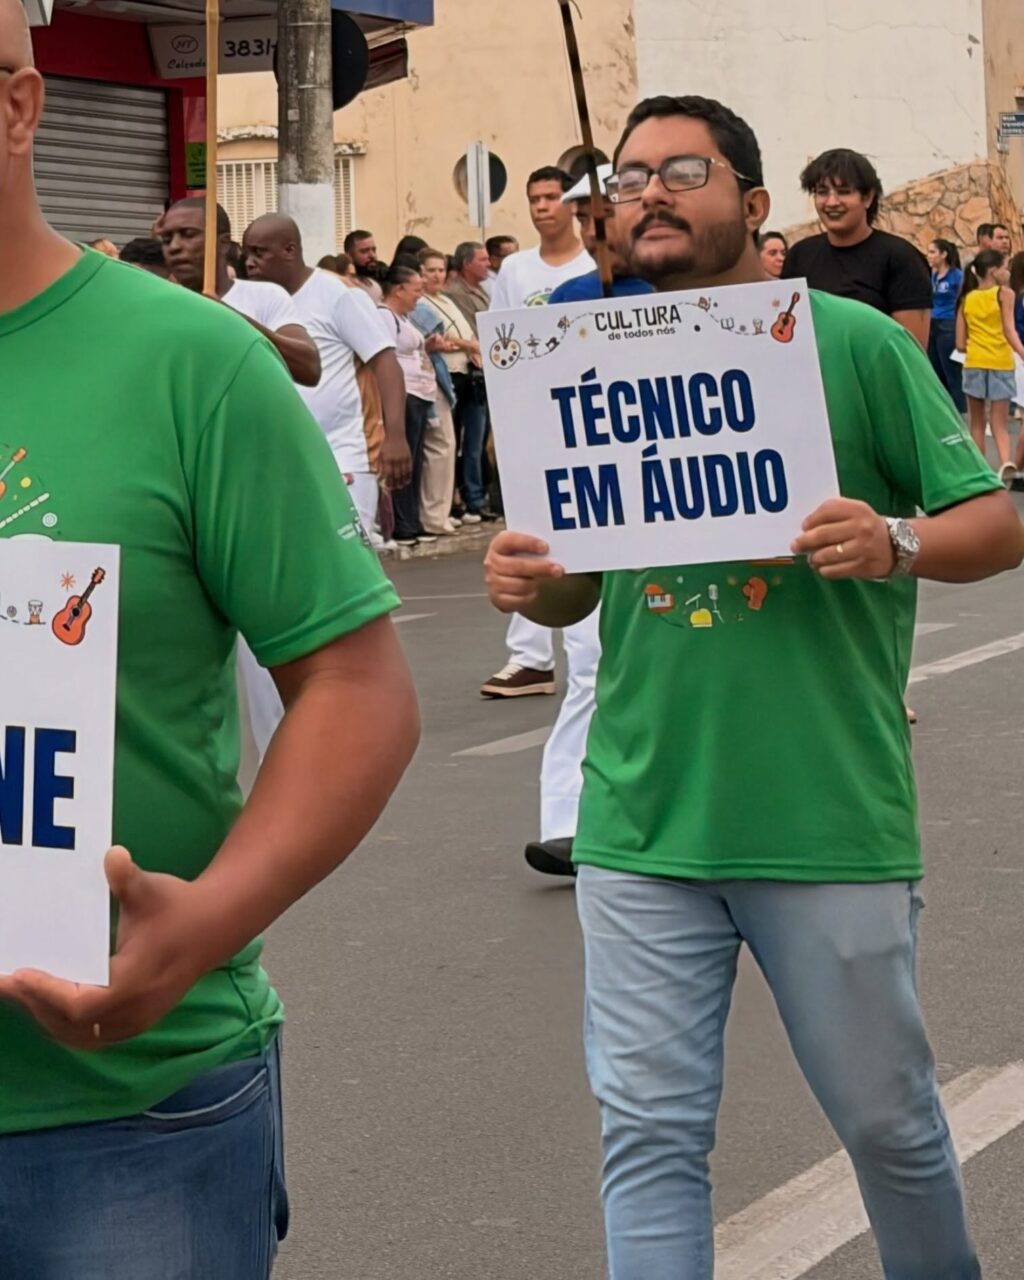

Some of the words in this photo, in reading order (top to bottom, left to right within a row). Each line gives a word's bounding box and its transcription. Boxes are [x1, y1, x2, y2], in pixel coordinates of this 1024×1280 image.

[595, 304, 682, 332] CULTURA
[608, 331, 621, 341] de
[624, 328, 654, 339] todos
[656, 325, 676, 336] nós
[550, 367, 756, 449] TÉCNICO
[544, 463, 625, 531] EM
[641, 442, 789, 524] ÁUDIO
